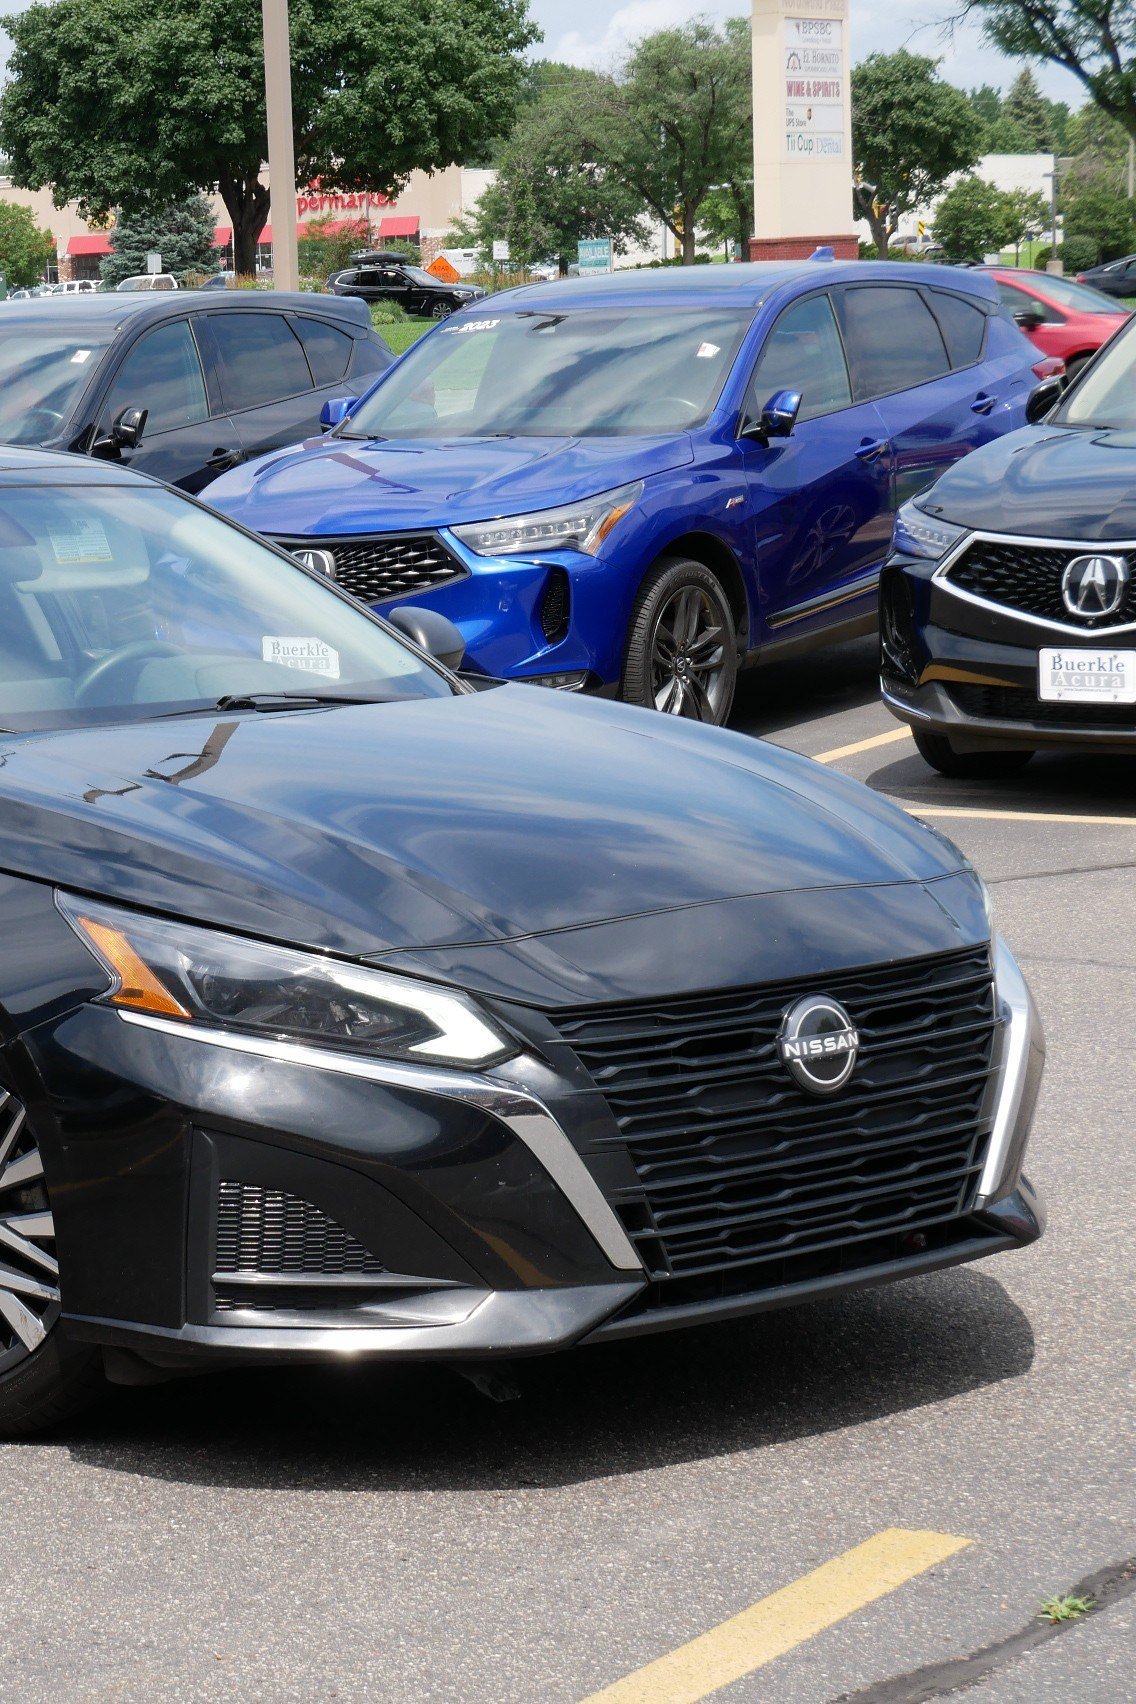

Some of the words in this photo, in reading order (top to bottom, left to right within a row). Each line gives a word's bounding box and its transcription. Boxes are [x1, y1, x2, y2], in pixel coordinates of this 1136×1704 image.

[786, 80, 805, 97] WINE
[806, 81, 811, 97] &
[812, 81, 840, 97] SPIRITS
[786, 118, 794, 127] UPS
[796, 118, 806, 127] Store
[797, 134, 813, 155] Cup
[816, 137, 842, 154] Dental
[271, 641, 329, 657] Buerkle
[275, 656, 328, 669] Acura
[1051, 655, 1125, 672] Buerkle
[1054, 672, 1122, 687] Acura
[784, 1032, 859, 1057] NISSAN
